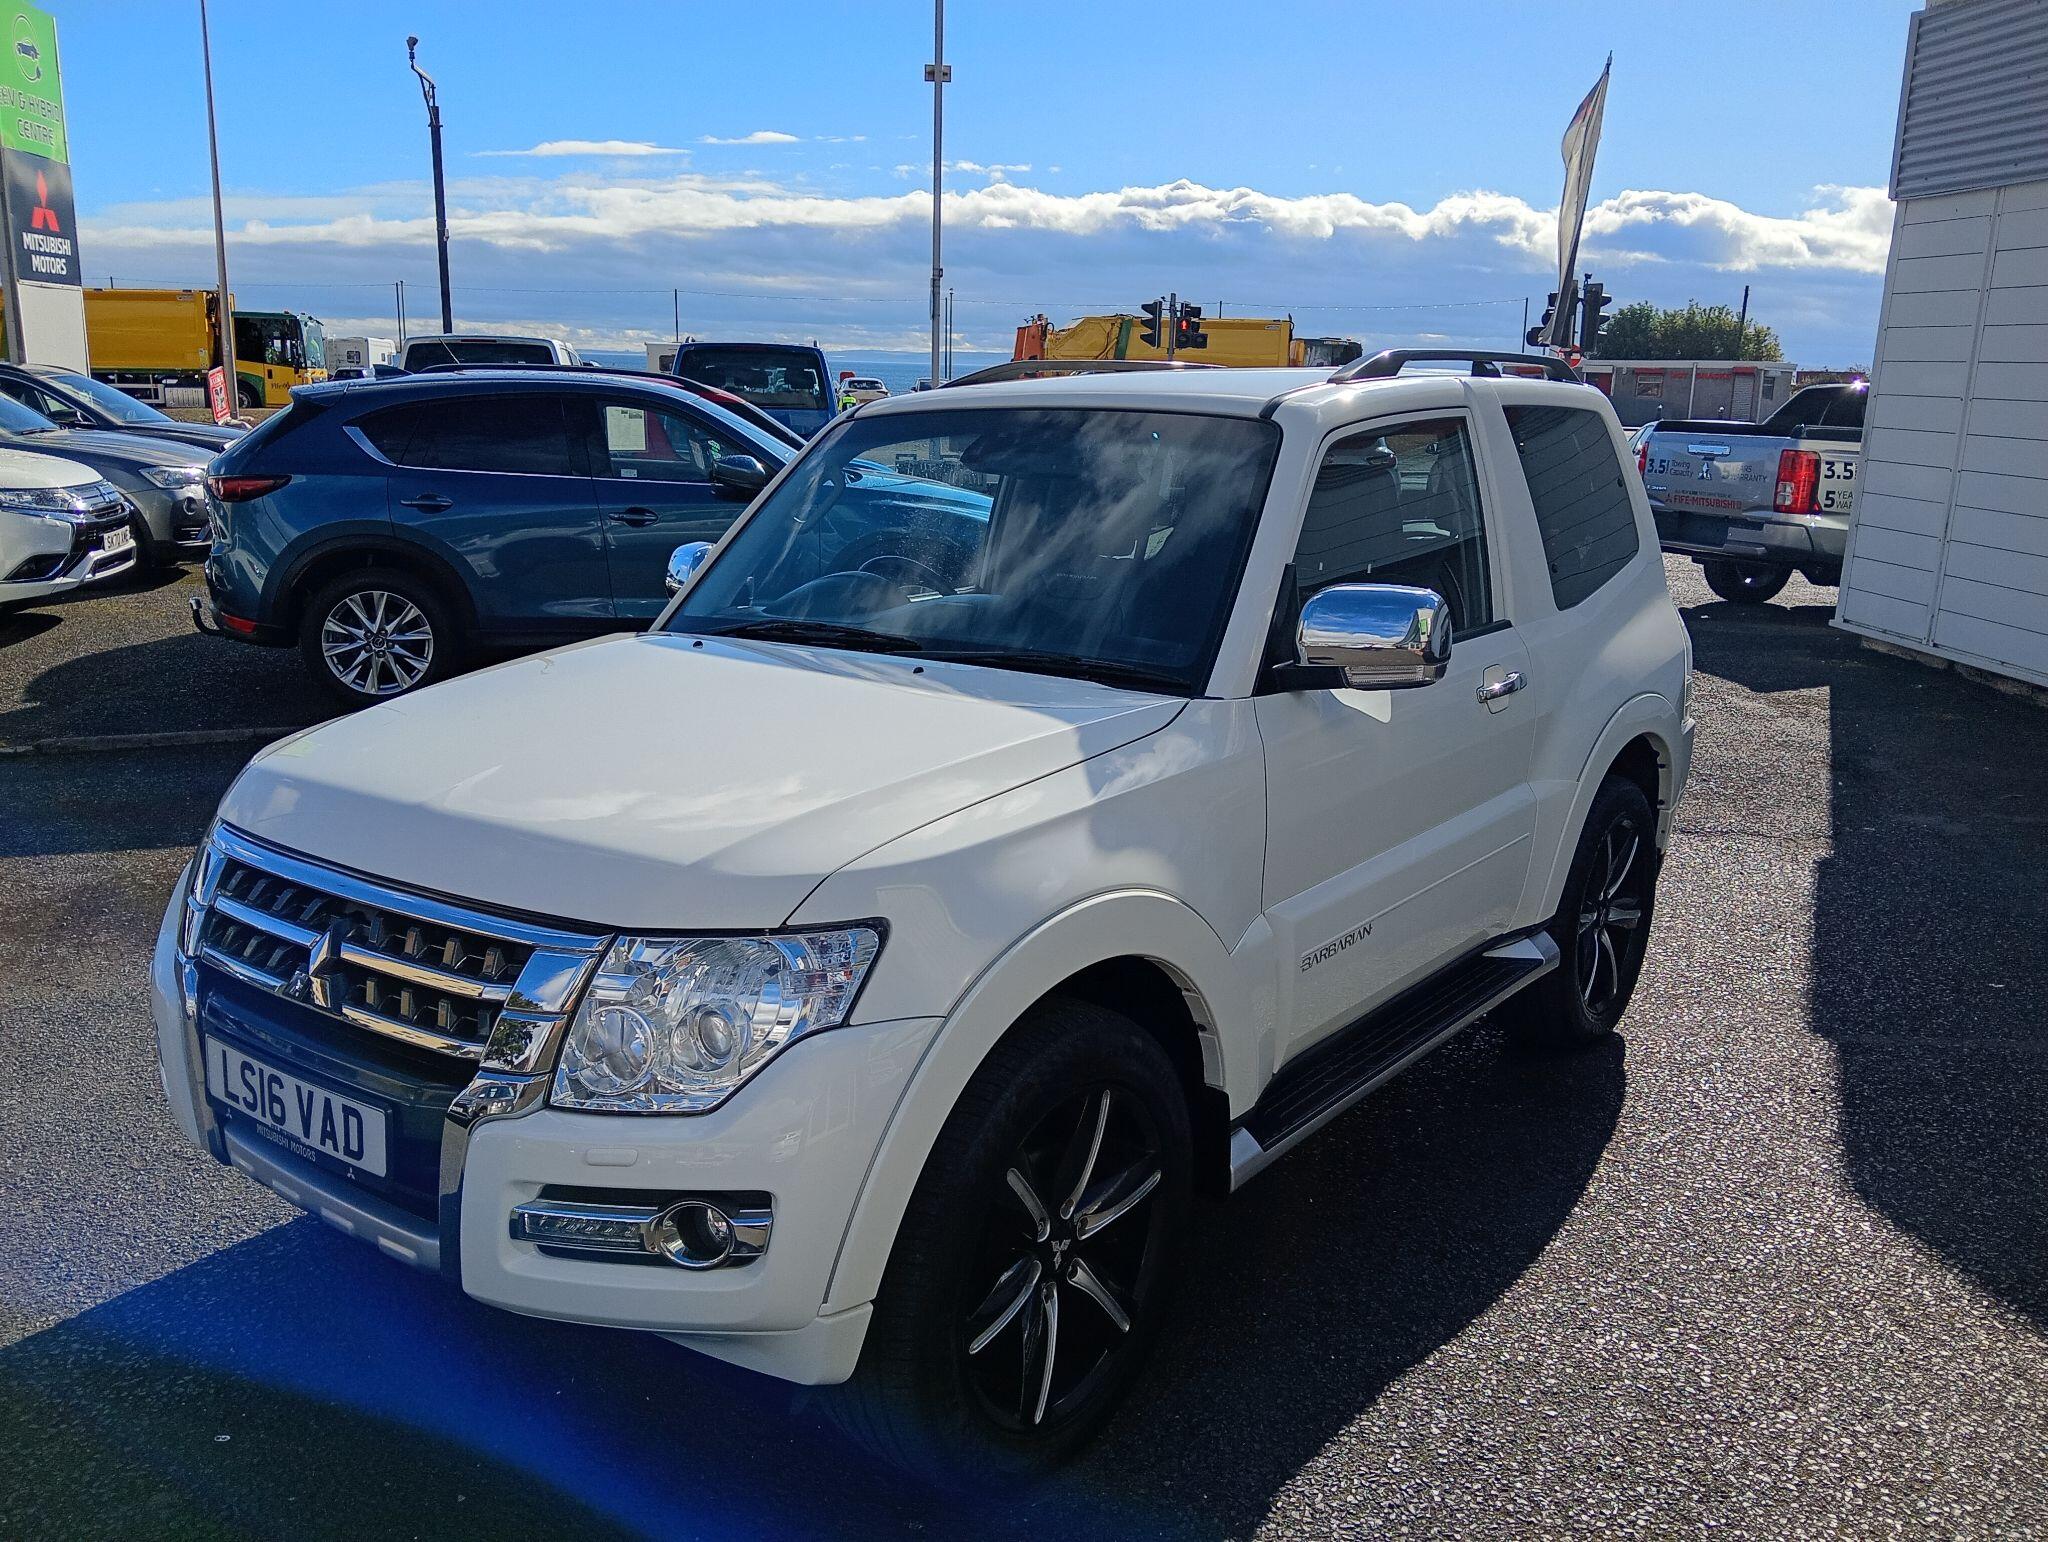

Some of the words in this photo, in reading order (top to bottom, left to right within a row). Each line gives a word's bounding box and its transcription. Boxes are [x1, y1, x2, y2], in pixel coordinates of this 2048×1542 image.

[28, 94, 60, 124] HYBRID
[17, 118, 54, 147] CENTRE
[22, 231, 72, 256] MITSUBISHI
[31, 254, 67, 275] MOTORS
[1670, 468, 1694, 478] Capacity
[1671, 459, 1690, 469] Towing
[1824, 461, 1854, 480] 3.5
[1823, 490, 1835, 508] 5
[1300, 923, 1373, 973] BARBARIAN
[222, 1049, 286, 1127] LS16
[296, 1084, 363, 1161] VAD
[256, 1123, 289, 1149] MITSUBISHI
[290, 1140, 316, 1162] MOTORS
